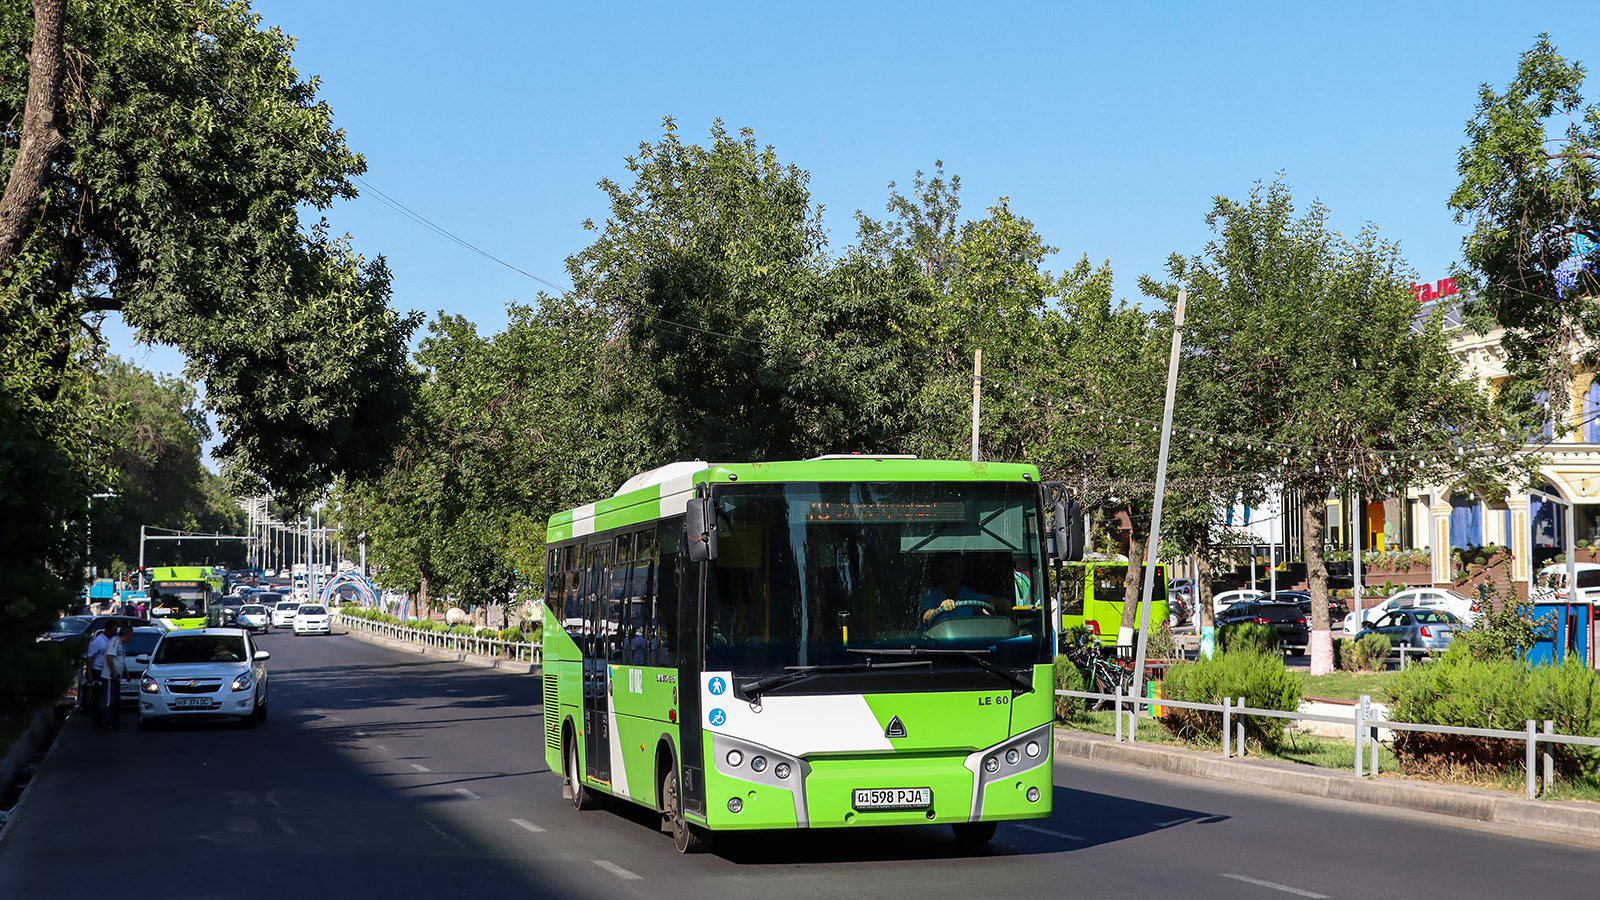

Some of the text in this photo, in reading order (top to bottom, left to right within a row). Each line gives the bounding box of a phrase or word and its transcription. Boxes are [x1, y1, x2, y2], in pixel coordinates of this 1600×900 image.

[978, 695, 1009, 706] LE 60
[871, 790, 894, 804] 598
[897, 790, 923, 803] PJA
